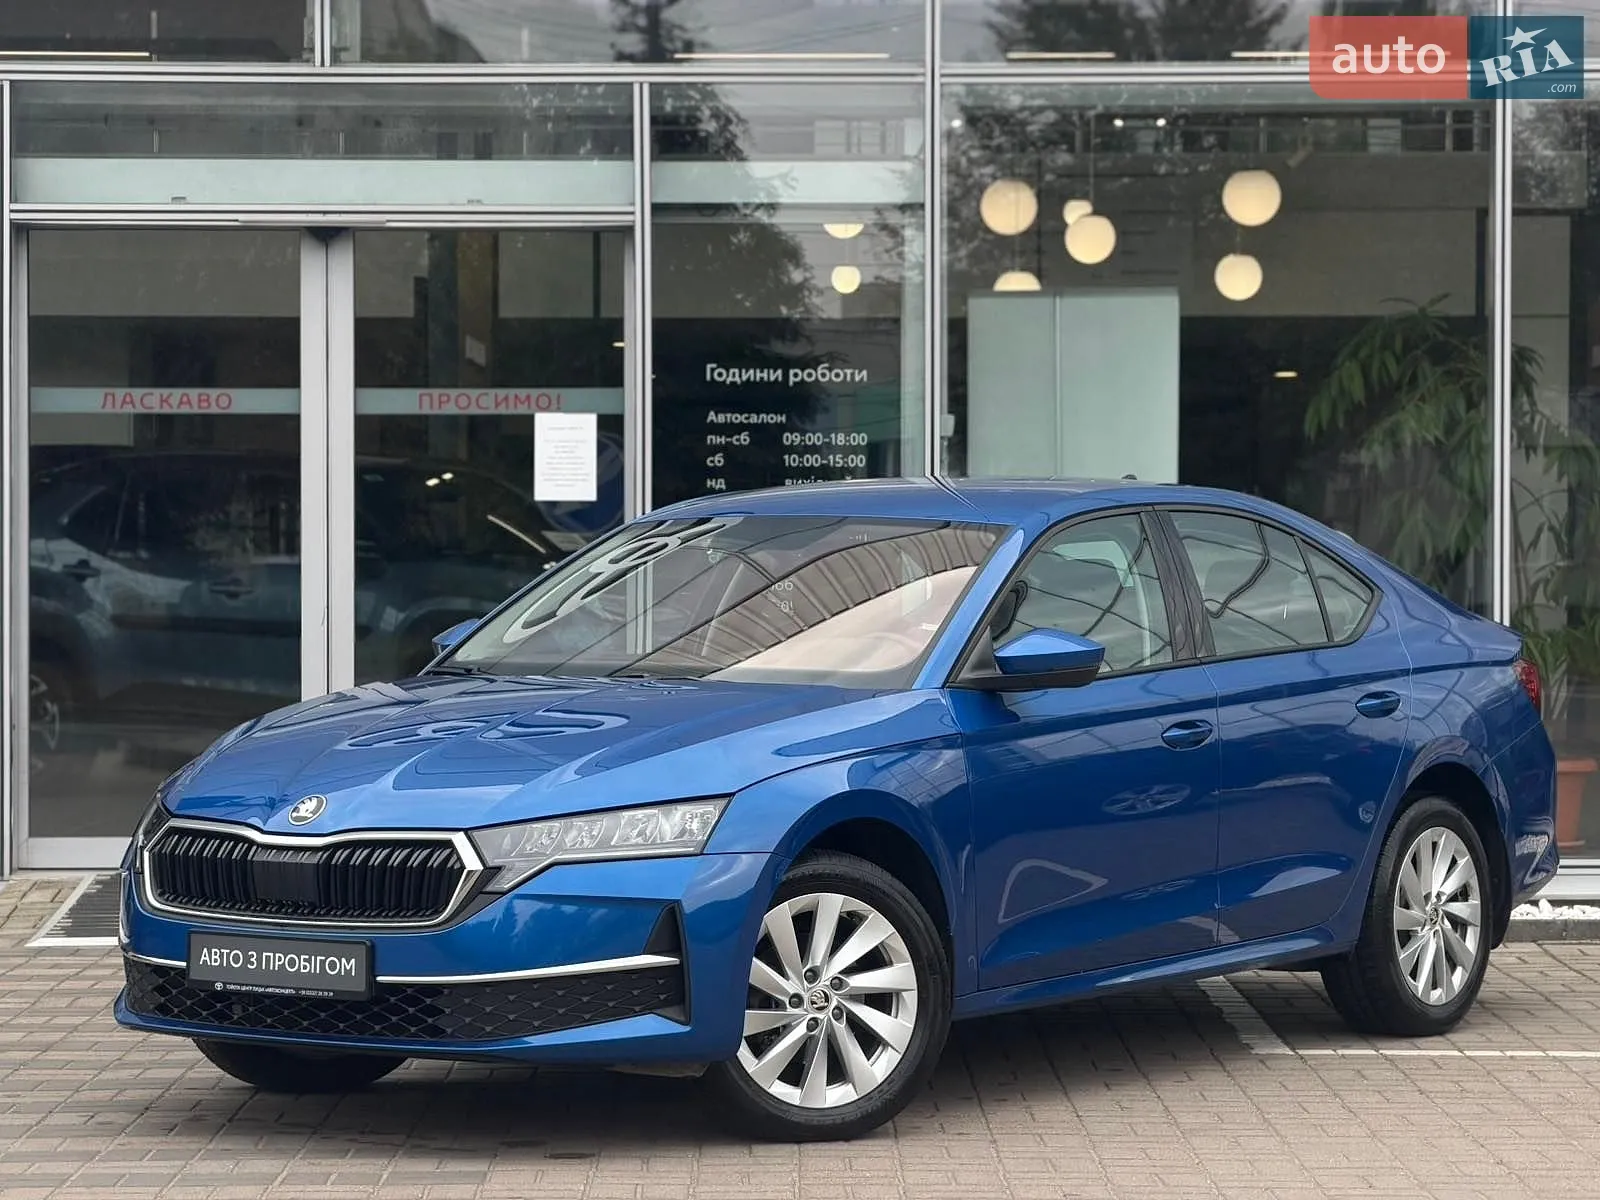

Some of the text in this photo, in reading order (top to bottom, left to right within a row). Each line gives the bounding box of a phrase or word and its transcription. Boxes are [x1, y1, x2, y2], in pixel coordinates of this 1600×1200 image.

[705, 363, 868, 387] Години роботи
[101, 391, 233, 411] ЛАСКАВО
[418, 391, 562, 411] ПРОСИМО!
[706, 410, 786, 424] Автосалон
[706, 431, 868, 446] пн-сб 09:00-18:00
[706, 453, 866, 468] сб 10:00-15:00
[706, 476, 726, 489] нд
[199, 947, 244, 969] АВТО
[262, 952, 356, 977] ПРОБІГОМ
